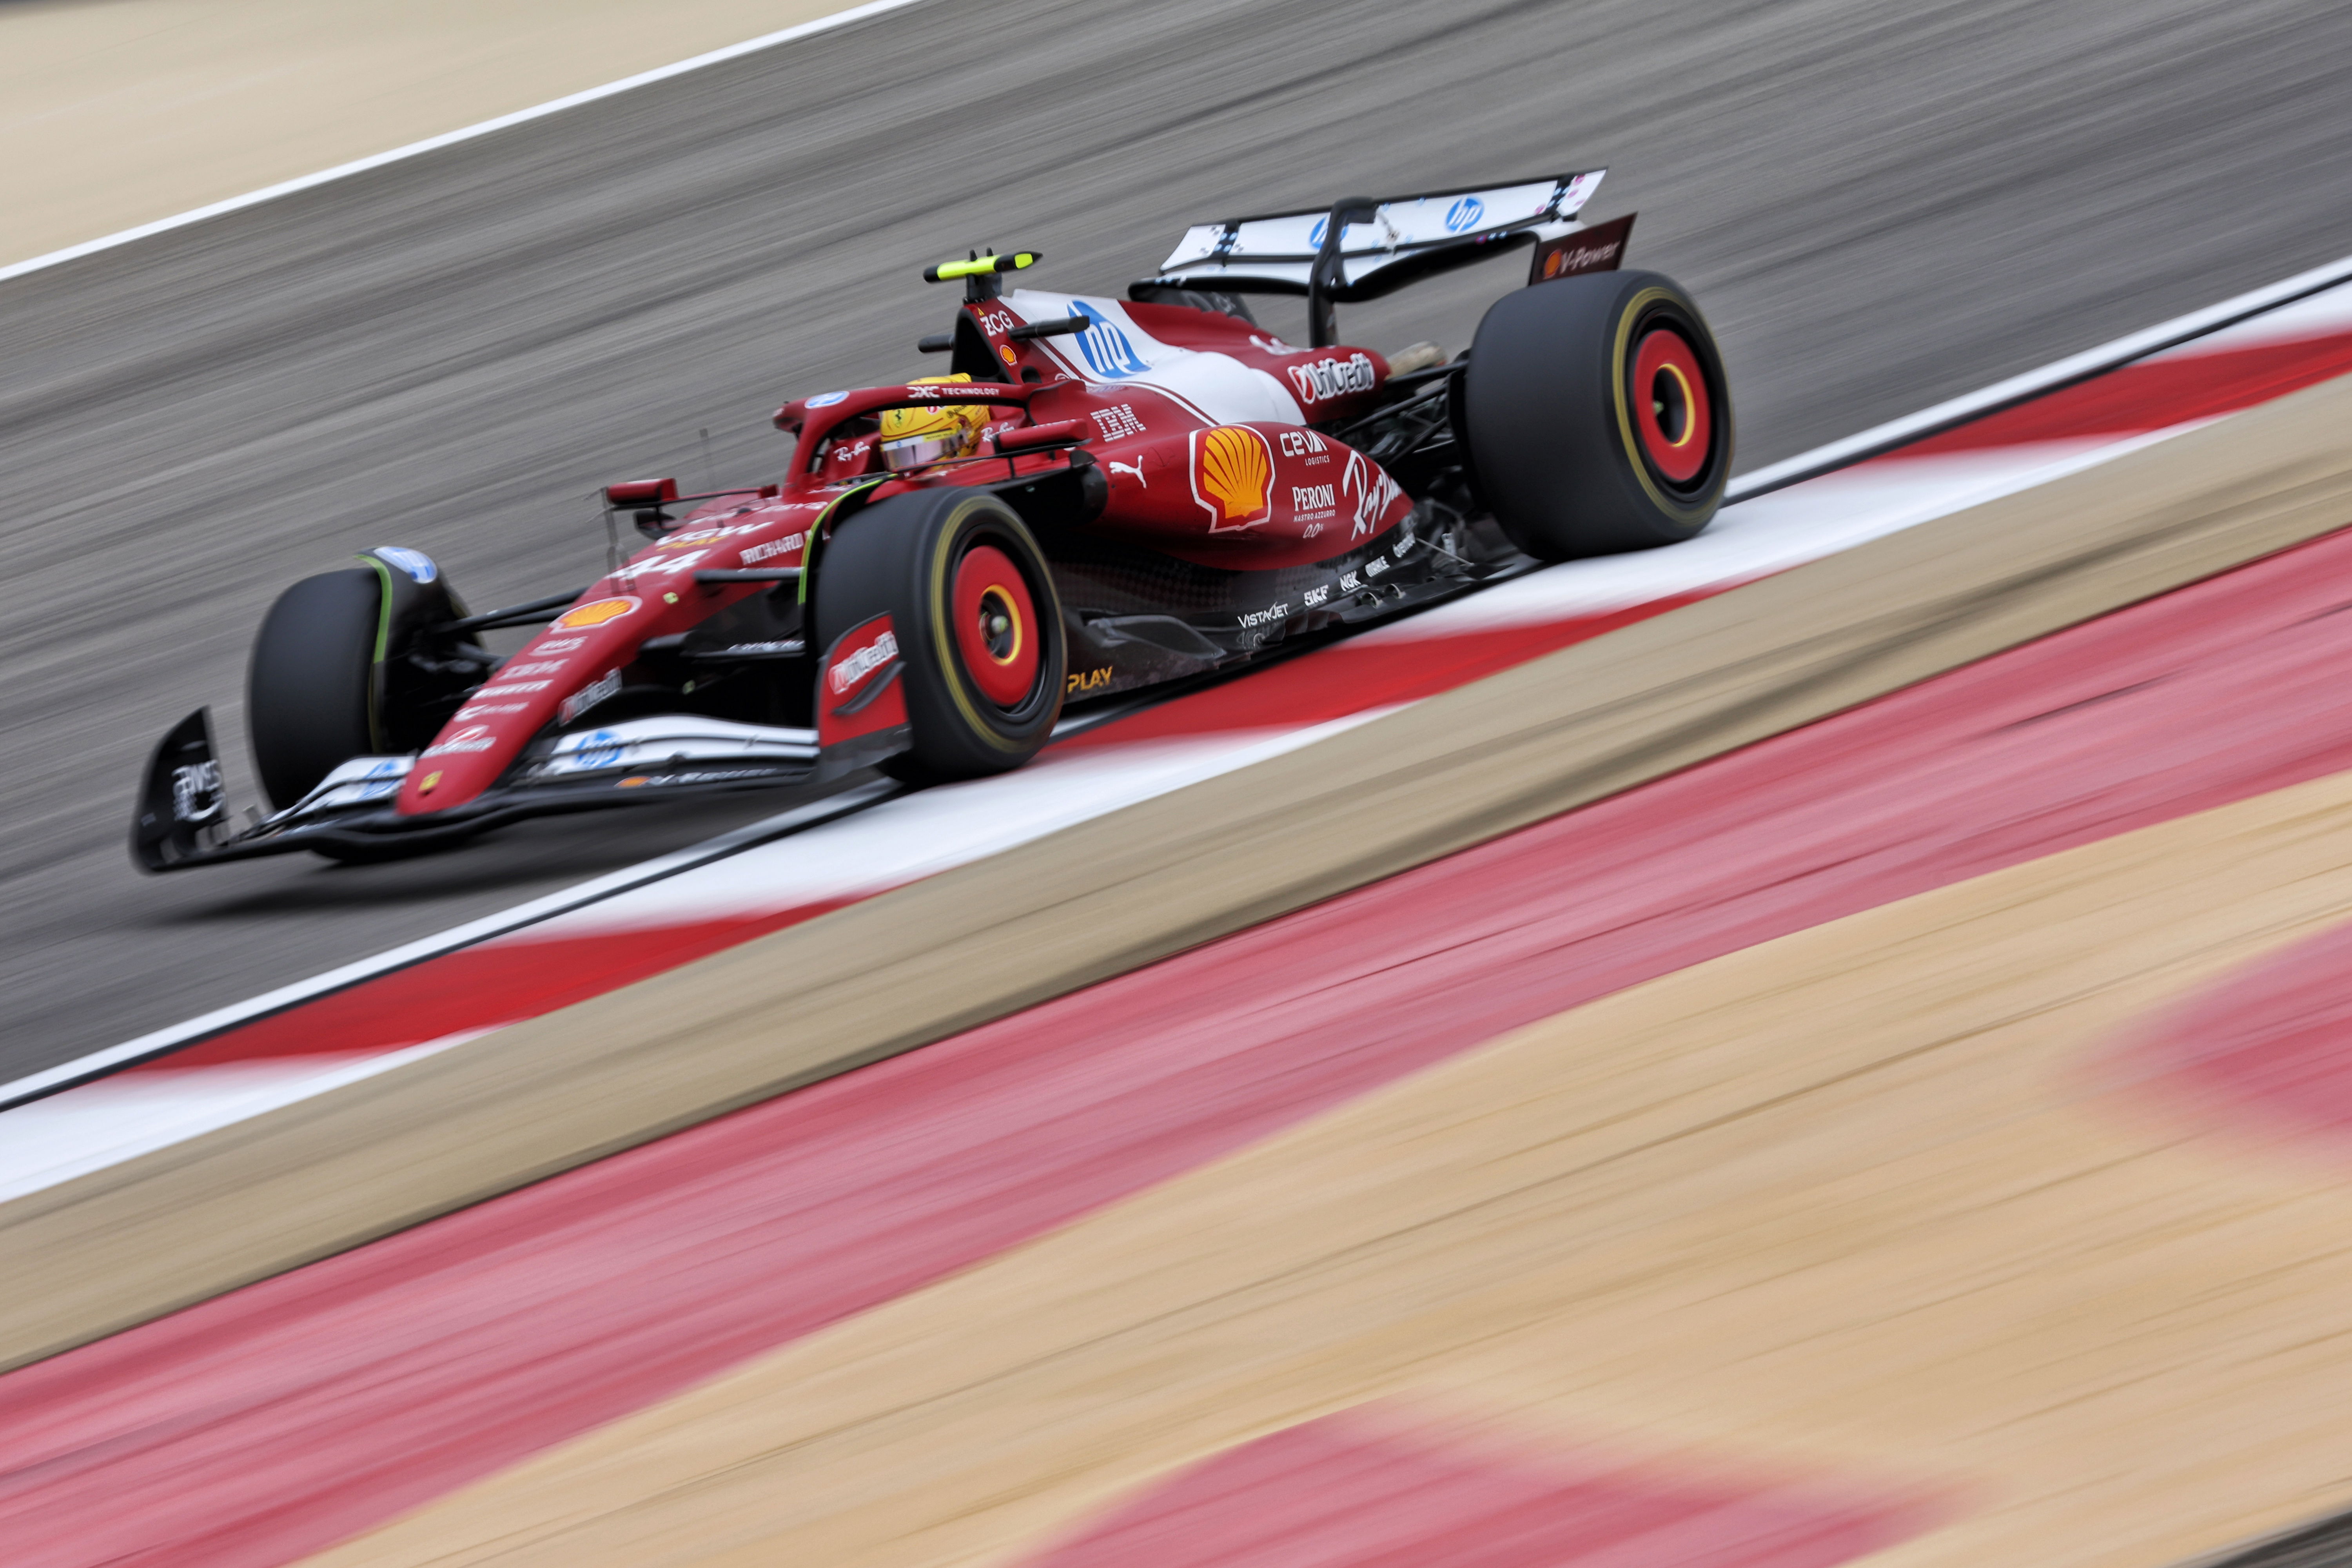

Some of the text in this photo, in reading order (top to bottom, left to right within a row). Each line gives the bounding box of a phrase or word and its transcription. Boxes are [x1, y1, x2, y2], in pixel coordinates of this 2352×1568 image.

[1448, 196, 1483, 234] hp
[1560, 241, 1621, 274] V-Power
[980, 310, 1014, 337] ZCG
[906, 386, 940, 398] DXC
[1090, 403, 1147, 442] IBM
[1305, 455, 1330, 466] LOGISTICS
[1292, 483, 1335, 512] PERONI
[1294, 510, 1336, 522] NASTRO AZZURRO
[603, 548, 711, 581] 44
[1339, 570, 1361, 592] NGK
[1304, 584, 1329, 606] SKF
[1067, 666, 1113, 693] PLAY
